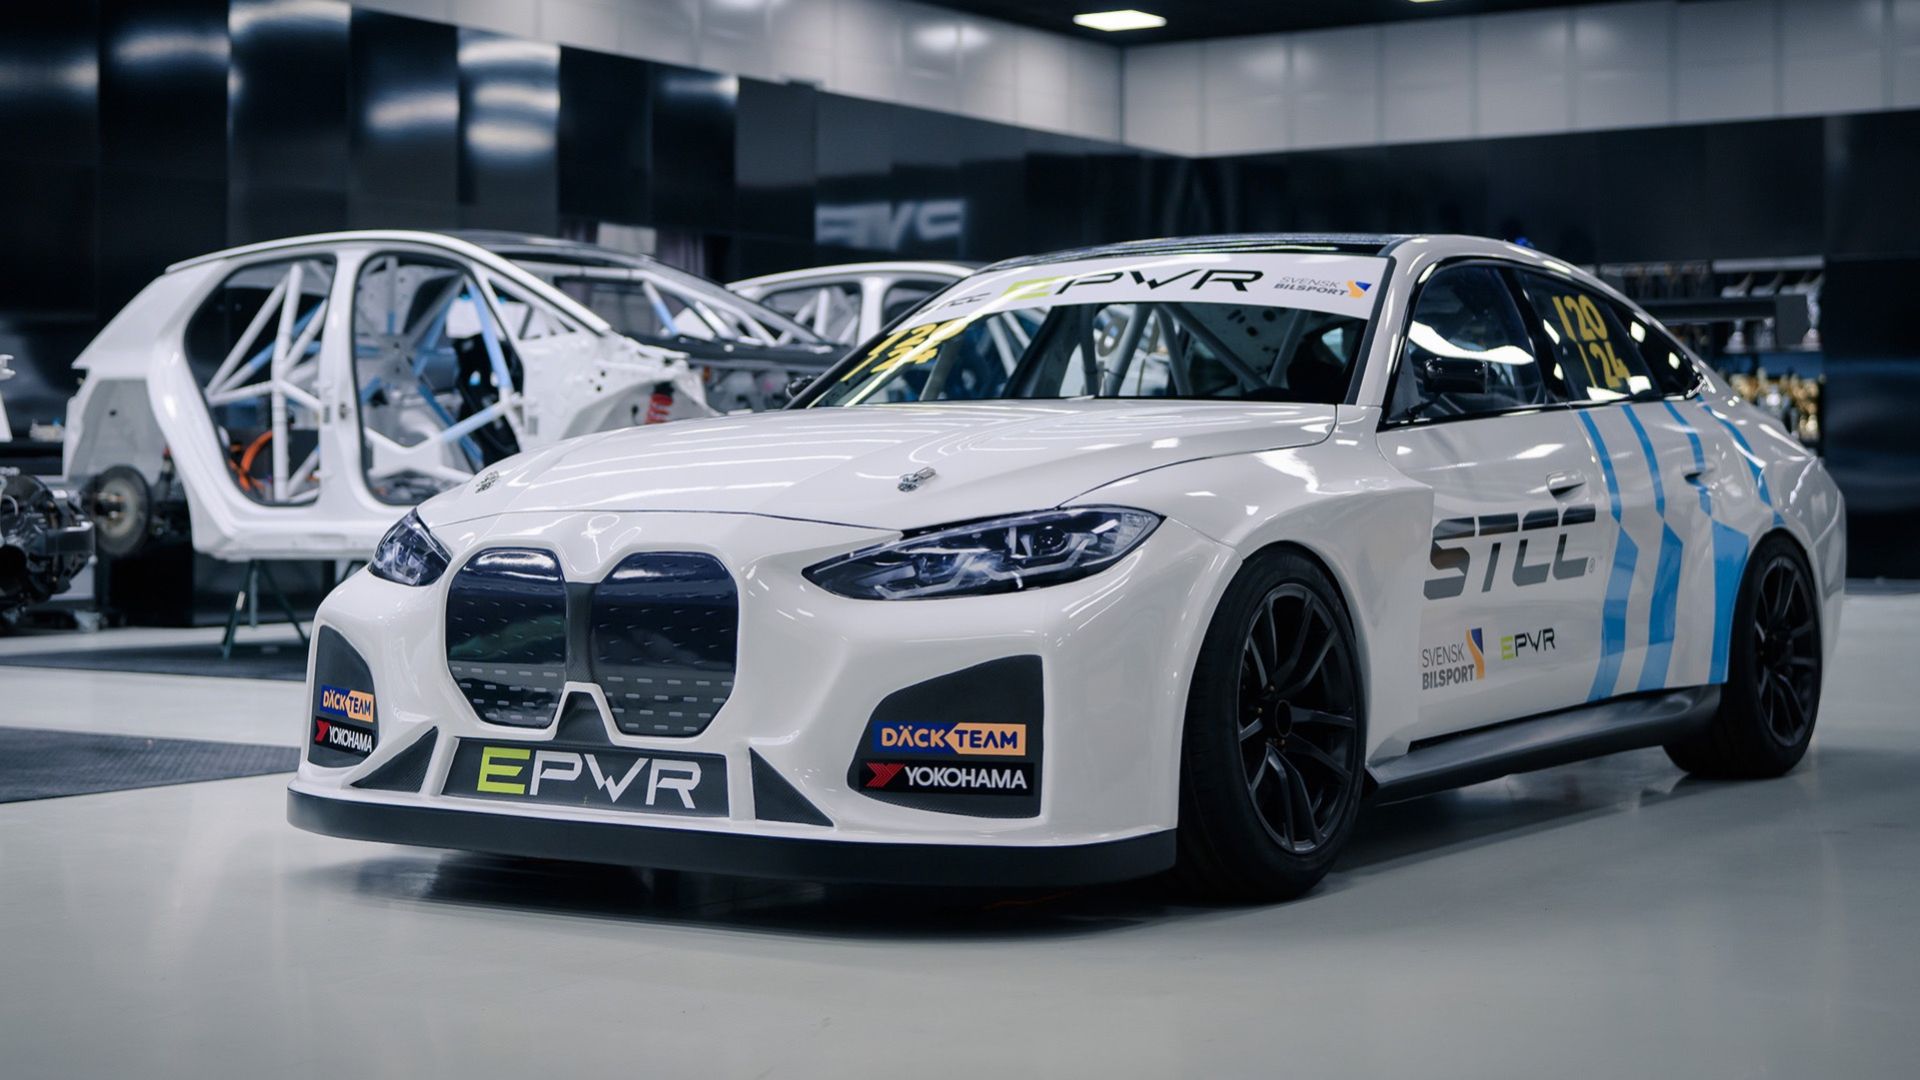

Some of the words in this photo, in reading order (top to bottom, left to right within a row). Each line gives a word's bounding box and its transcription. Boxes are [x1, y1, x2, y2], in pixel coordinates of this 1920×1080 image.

[1001, 269, 1264, 300] EPWR
[1274, 283, 1348, 296] BILSPORT
[1282, 276, 1340, 289] SVENSK
[1422, 642, 1465, 668] SVENSK
[1501, 627, 1556, 660] EPWR
[1422, 664, 1475, 690] BILSPORT
[323, 689, 346, 711] DÄCK
[349, 695, 372, 716] TEAM
[329, 725, 373, 753] YOKOHAMA
[881, 725, 946, 748] DÄCK
[954, 729, 1018, 749] TEAM
[477, 746, 702, 809] EPWR
[904, 766, 1028, 790] YOKOHAMA
